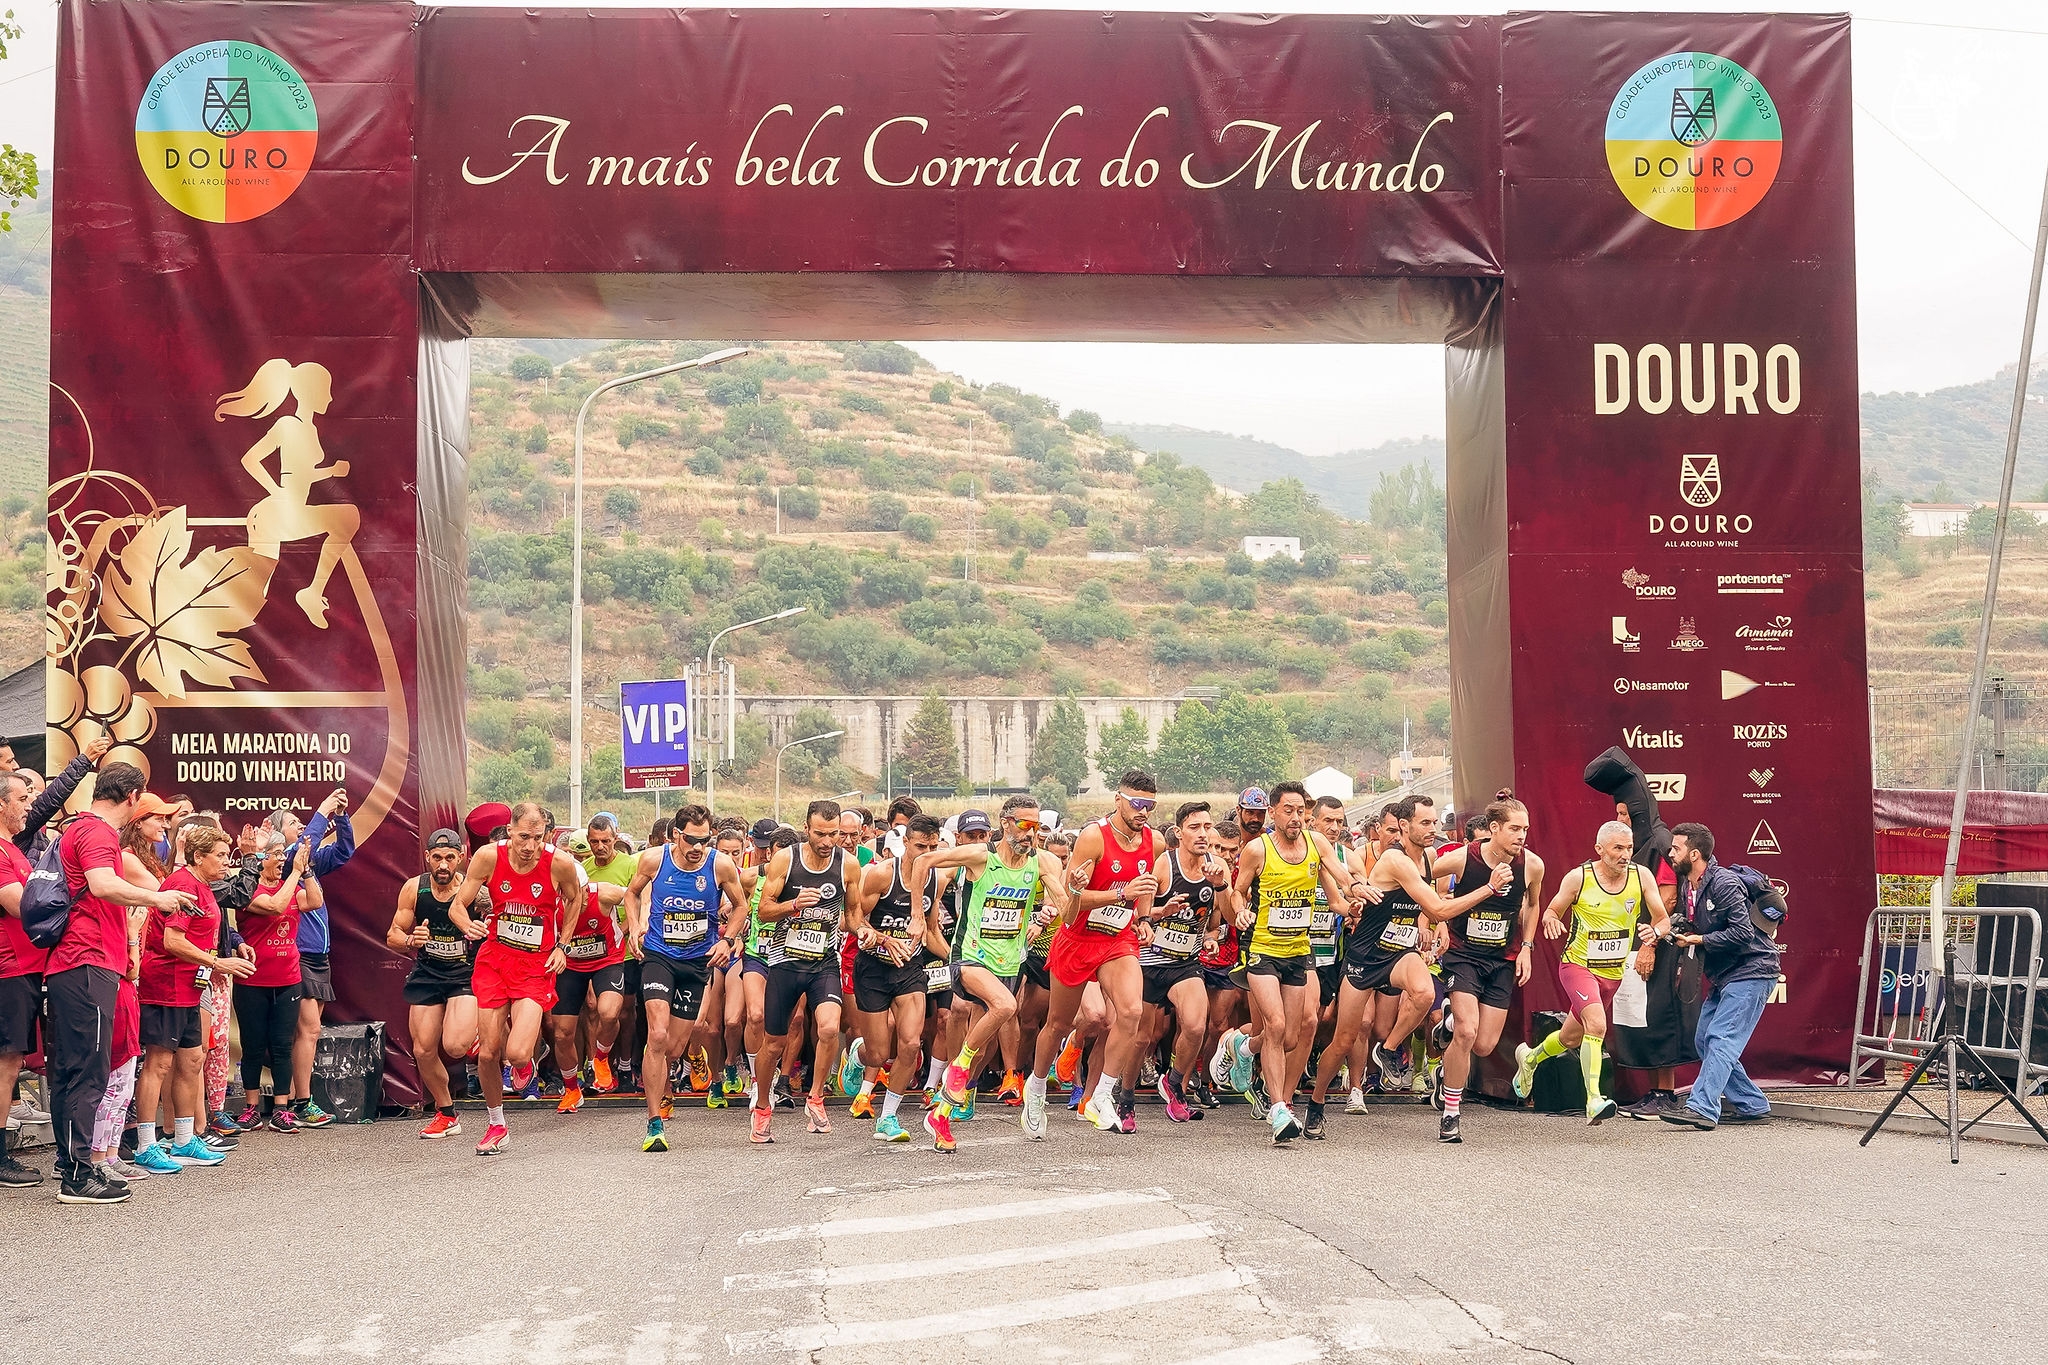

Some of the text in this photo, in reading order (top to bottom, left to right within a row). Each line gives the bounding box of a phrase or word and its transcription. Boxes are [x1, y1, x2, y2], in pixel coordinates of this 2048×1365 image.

[147, 48, 308, 110] CIDADE EUROPEIA DO VINHO 2023
[1616, 59, 1772, 121] CIDADE EUROPEIA DO VINHO 2023
[461, 104, 1454, 193] A mais bela Corrida do Mundo
[165, 148, 287, 169] DOURO
[1635, 157, 1754, 177] DOURO
[200, 178, 241, 186] AROUND
[244, 178, 270, 186] WINE
[1652, 186, 1666, 194] ALL
[1594, 342, 1801, 415] DOURO
[1649, 514, 1753, 534] DOURO
[1664, 540, 1739, 548] ALL AROUND WINE
[1636, 586, 1676, 596] DOURO
[1671, 640, 1704, 648] LAMEGO
[1631, 680, 1689, 691] Nasamotor
[624, 703, 687, 744] VIP
[1733, 722, 1788, 740] ROZÈS
[1622, 725, 1684, 749] Vitalis
[171, 733, 351, 754] MEIA MARATONA DO
[177, 760, 346, 782] DOURO VINHATEIRO
[645, 778, 670, 788] DOURO
[225, 798, 312, 811] PORTUGAL
[1753, 839, 1776, 847] DELTA
[1266, 890, 1284, 899] U.D.
[996, 899, 1018, 908] DOURO
[674, 913, 696, 921] DOURO
[992, 910, 1017, 922] 3712
[1100, 906, 1126, 920] 4077
[1279, 909, 1303, 920] 3935
[1480, 911, 1502, 920] DOURO
[510, 915, 533, 925] DOURO
[801, 921, 822, 930] DOURO
[508, 923, 534, 937] 4072
[674, 922, 698, 933] 4156
[1169, 921, 1190, 932] DOURO
[1477, 921, 1503, 932] 3502
[797, 931, 822, 944] 3500
[1164, 931, 1190, 945] 4155
[1600, 931, 1620, 940] DOURO
[577, 937, 596, 946] DOURO
[1597, 940, 1622, 952] 4087
[577, 943, 599, 955] 2927
[925, 959, 944, 969] DOURO
